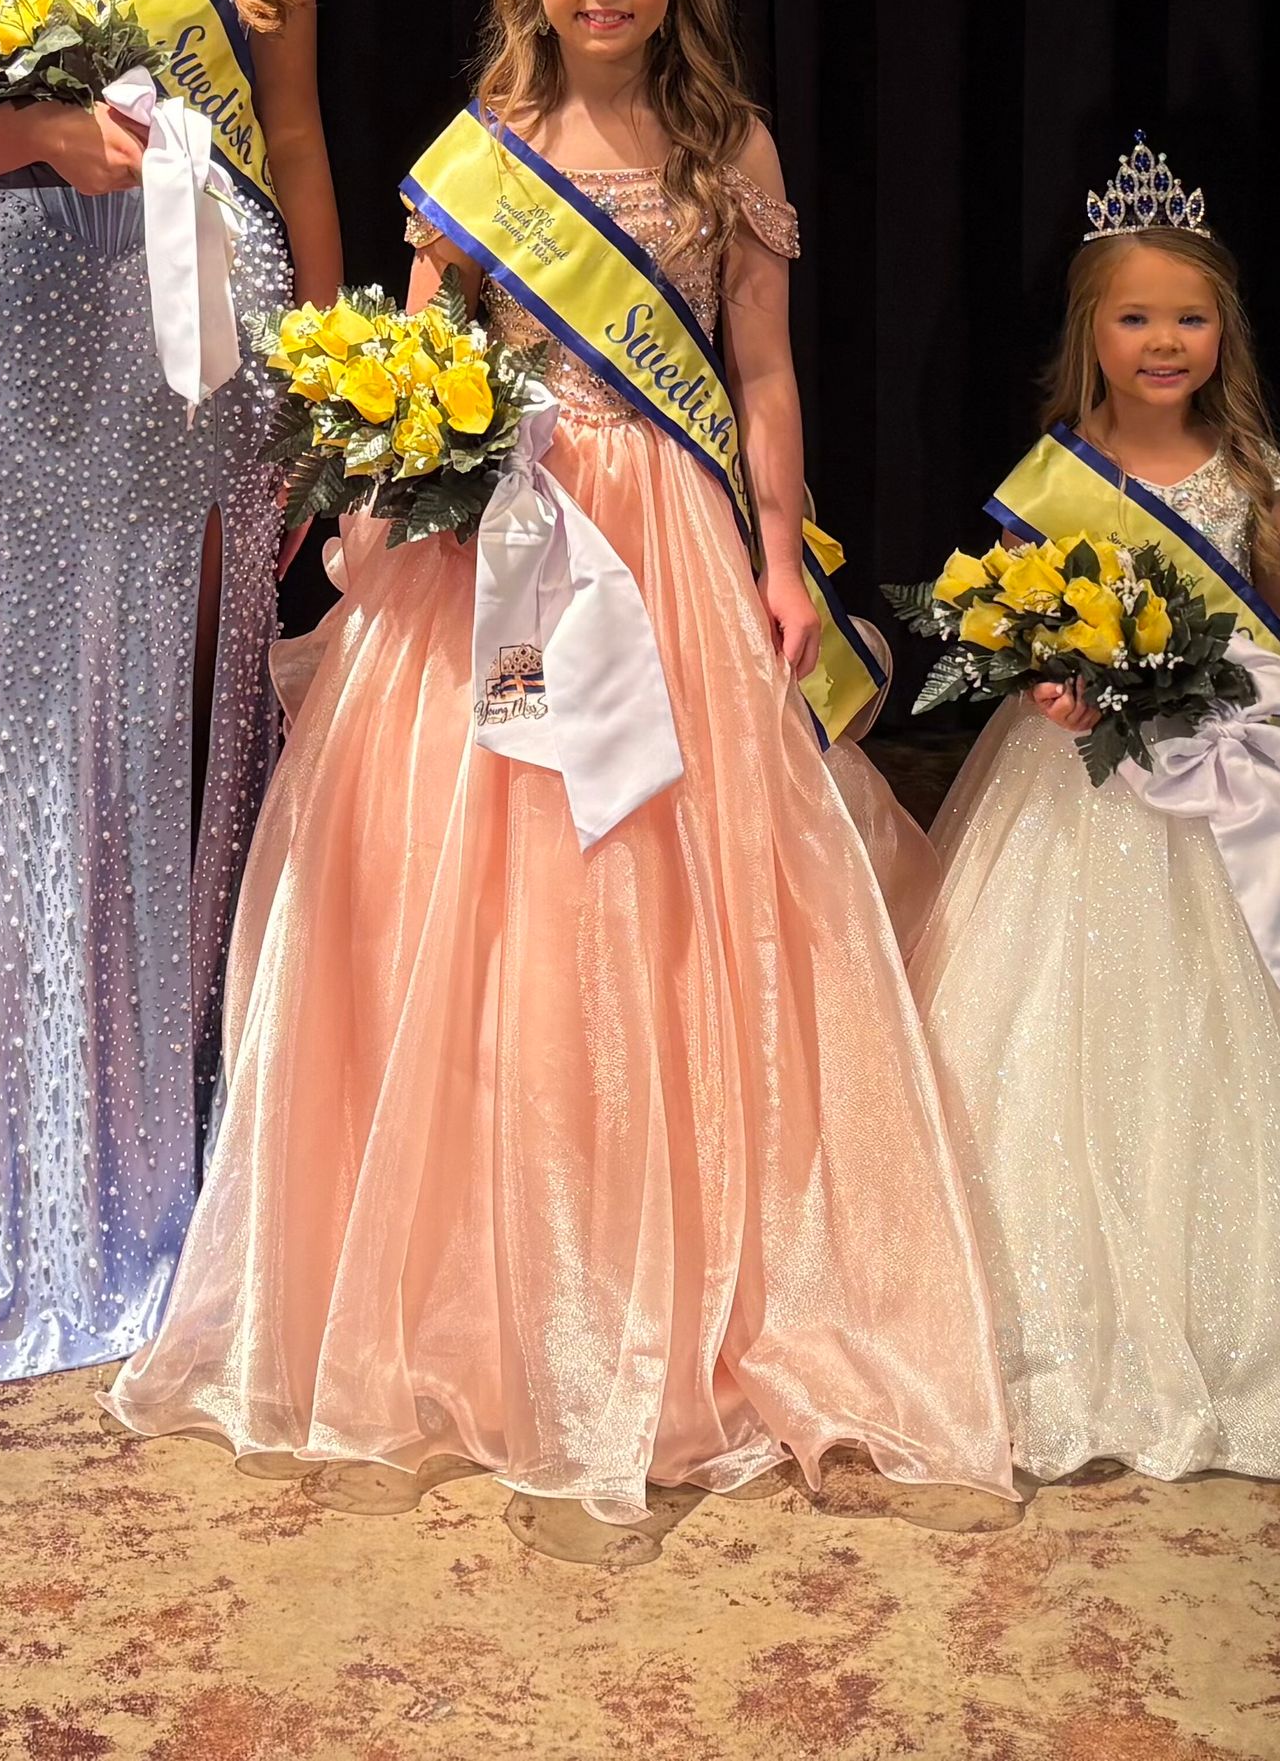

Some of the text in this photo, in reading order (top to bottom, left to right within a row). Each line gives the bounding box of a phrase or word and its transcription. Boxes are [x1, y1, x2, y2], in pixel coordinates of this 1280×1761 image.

[156, 25, 253, 165] Swedish
[527, 203, 556, 229] 2026
[604, 303, 734, 455] Swedish
[473, 699, 509, 727] Young
